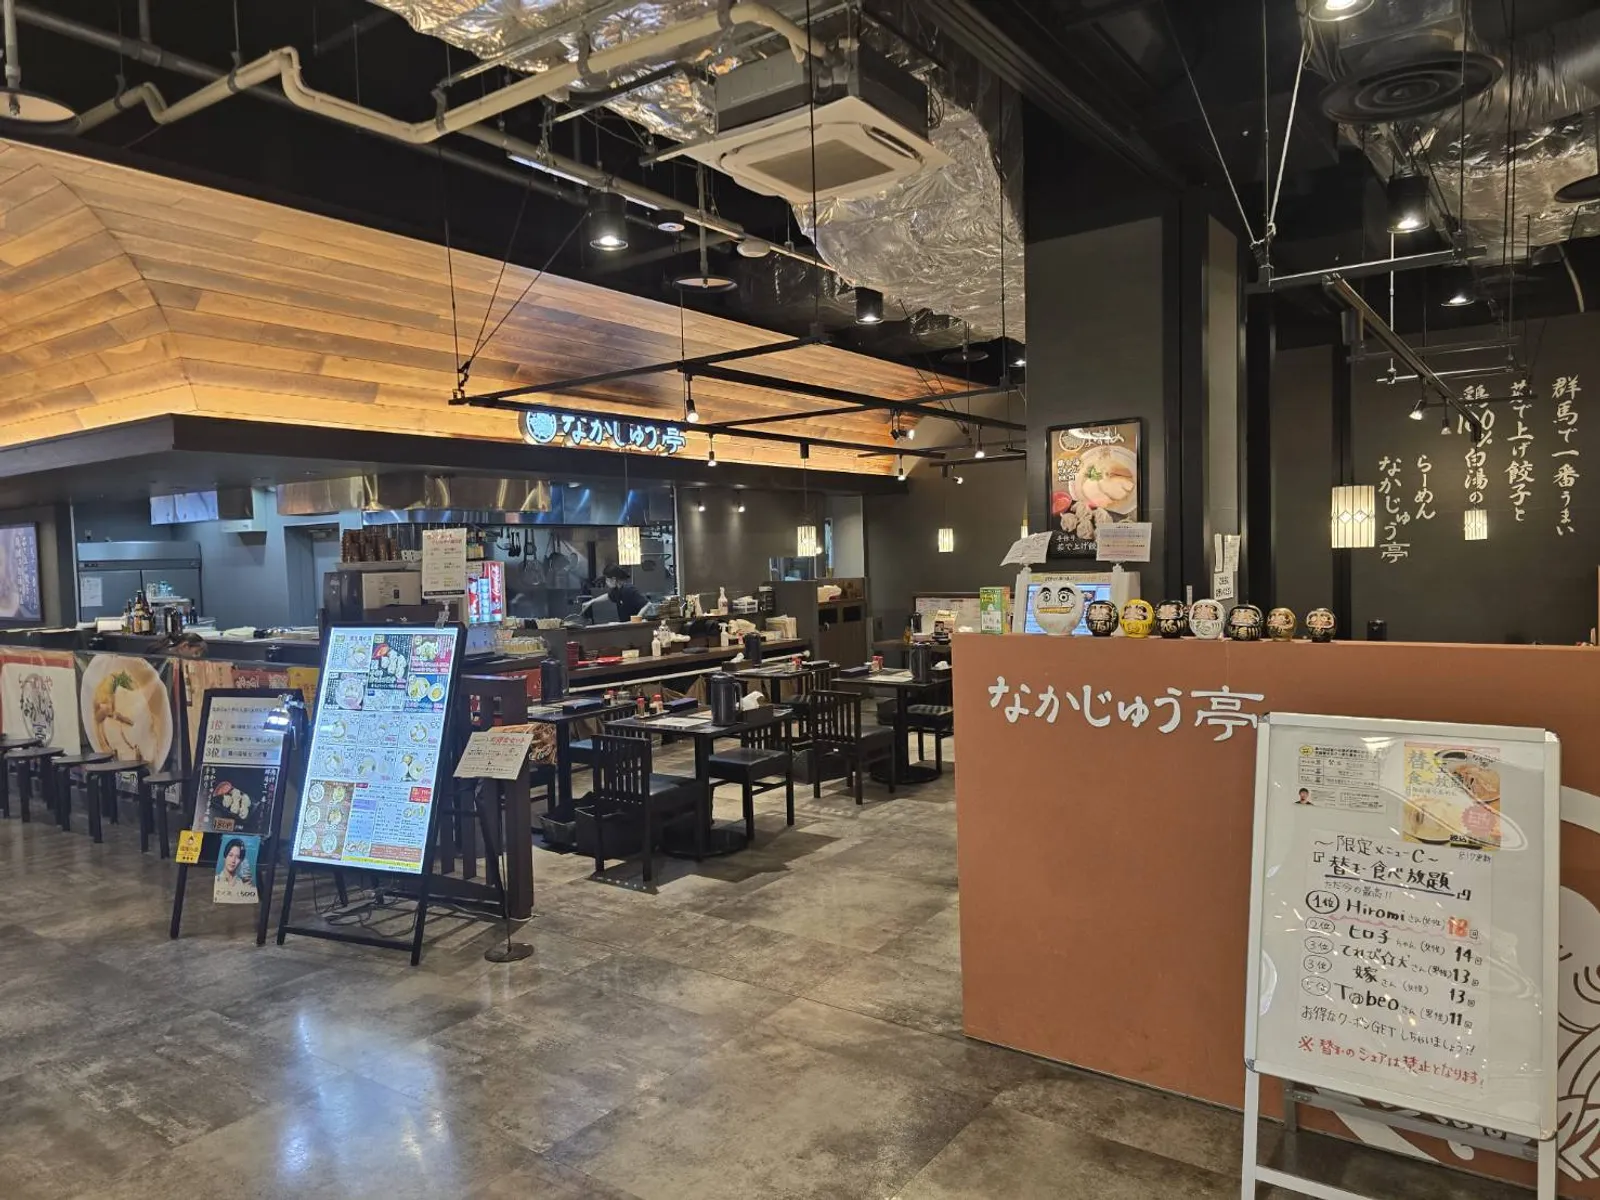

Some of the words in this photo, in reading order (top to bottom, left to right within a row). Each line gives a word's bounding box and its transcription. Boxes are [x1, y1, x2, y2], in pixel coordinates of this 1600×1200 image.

[1551, 374, 1583, 536] 群馬で一番うまい
[1378, 456, 1411, 564] なかじゅう亭
[1414, 454, 1437, 520] らーめん
[988, 675, 1265, 742] なかじゅう亭
[1347, 899, 1406, 922] Hiromi
[1349, 924, 1390, 944] ヒロ子
[1334, 982, 1399, 1011] T@beo
[1353, 965, 1378, 983] 嫁
